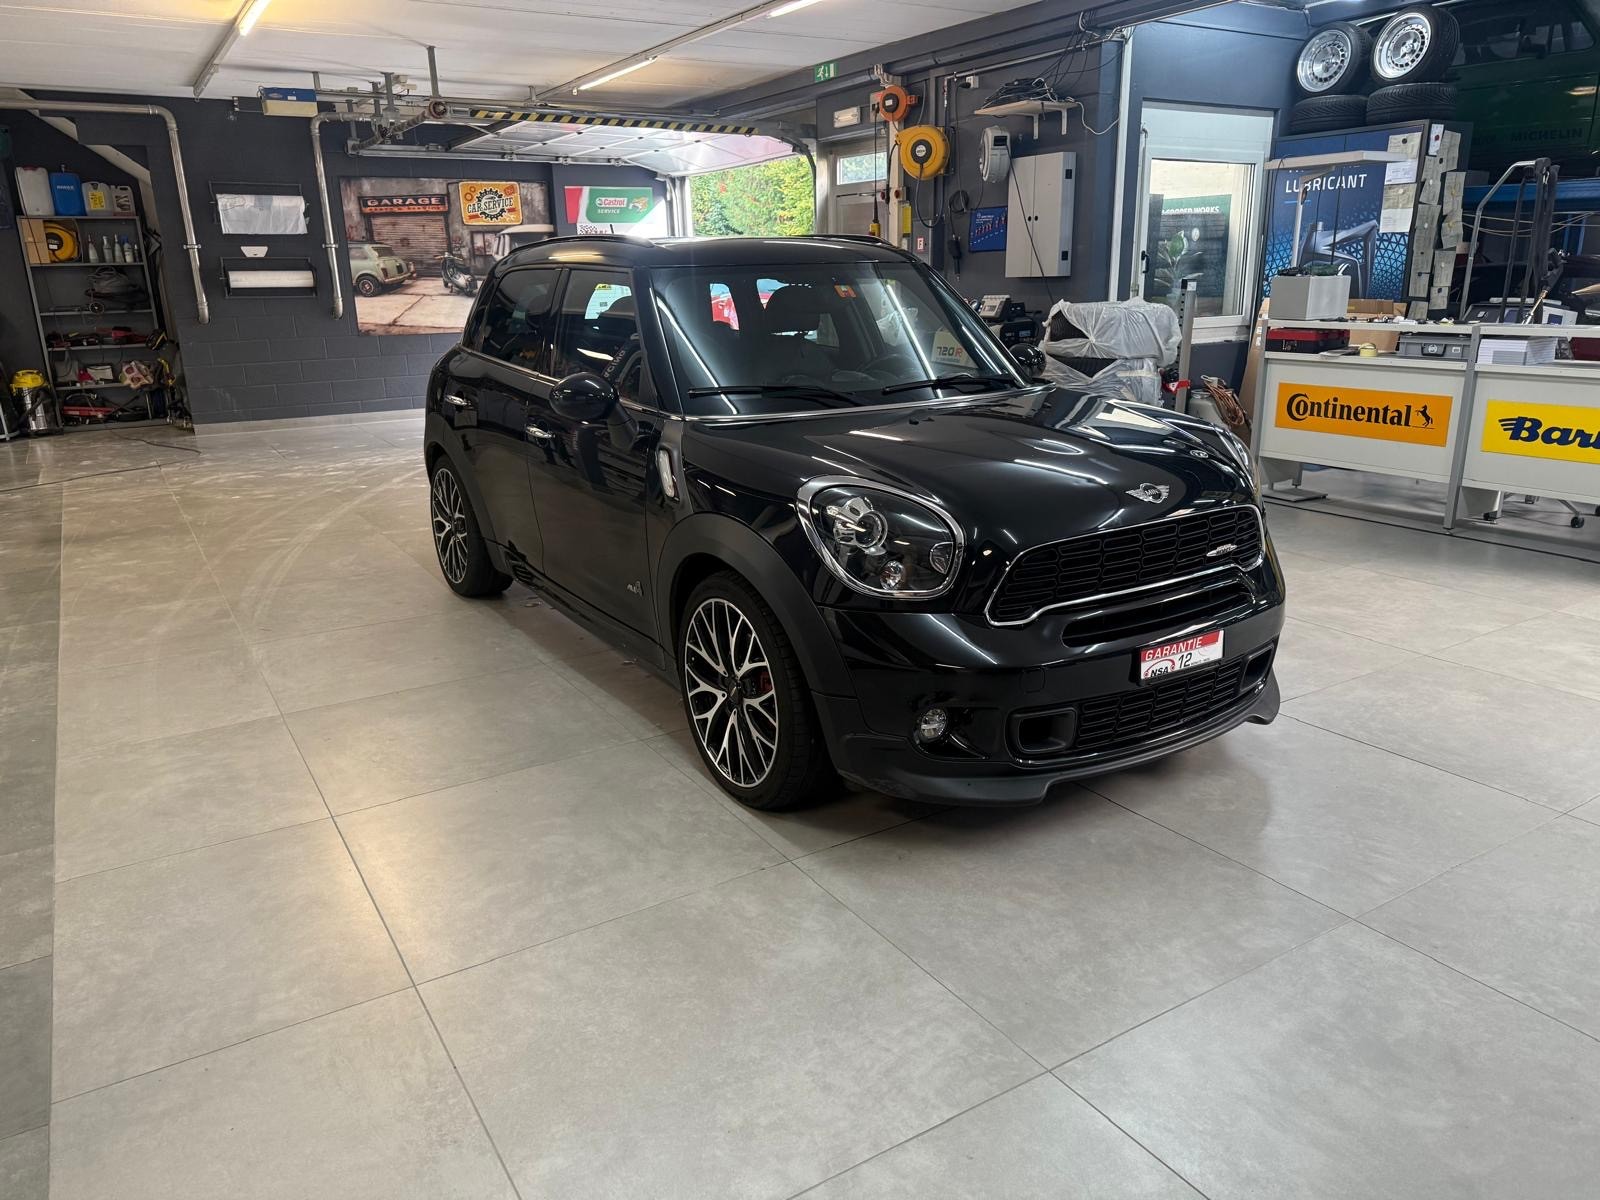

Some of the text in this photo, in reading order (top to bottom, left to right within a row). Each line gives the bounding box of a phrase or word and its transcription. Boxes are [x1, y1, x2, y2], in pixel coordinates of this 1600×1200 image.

[367, 197, 441, 206] GARAGE
[467, 197, 514, 213] CAR SERVICE
[603, 198, 625, 206] Castrol
[1193, 205, 1220, 214] WORKS
[1286, 393, 1412, 427] Continental
[1145, 636, 1203, 661] GARANTIE
[1150, 666, 1169, 678] NSA
[1178, 652, 1193, 669] 12
